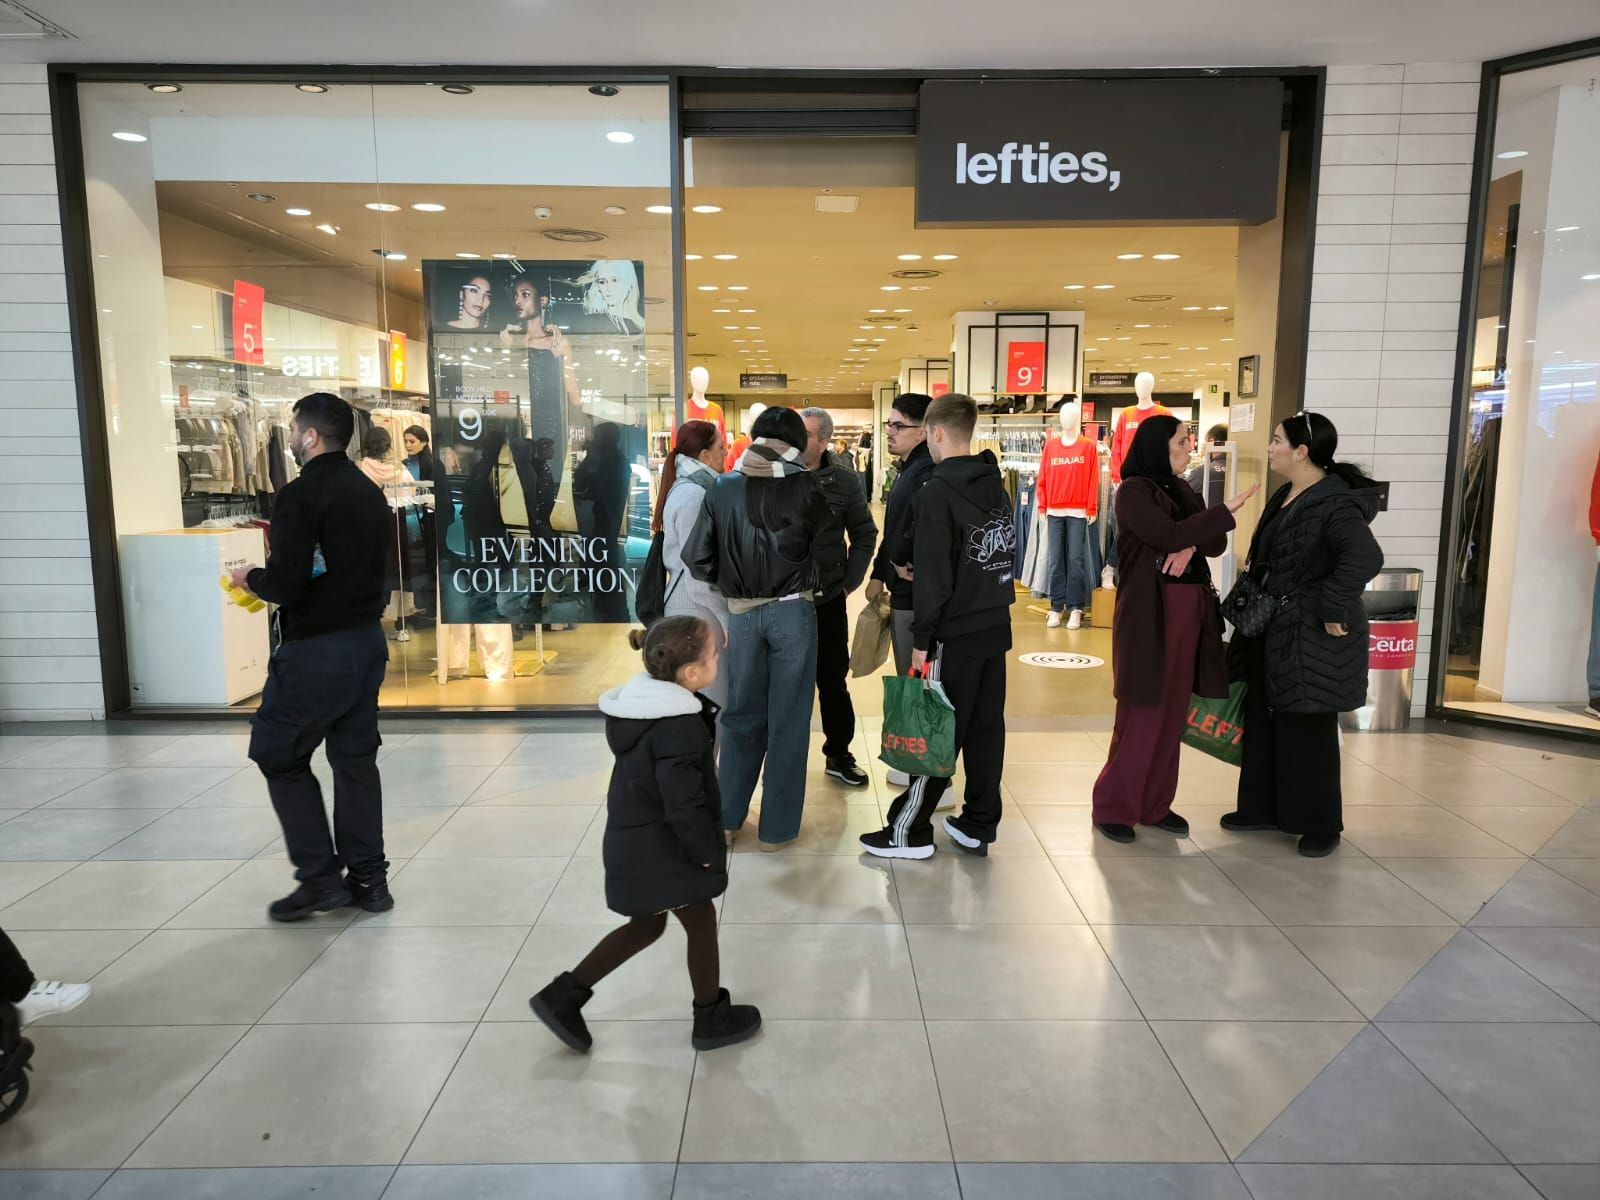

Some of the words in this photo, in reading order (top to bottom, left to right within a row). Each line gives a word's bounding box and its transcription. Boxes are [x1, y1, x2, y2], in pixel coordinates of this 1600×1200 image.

[956, 141, 1121, 192] lefties,
[243, 322, 255, 353] 5
[1017, 366, 1032, 387] 9
[459, 408, 482, 440] 9
[480, 537, 609, 563] EVENING
[452, 567, 637, 593] COLLECTION
